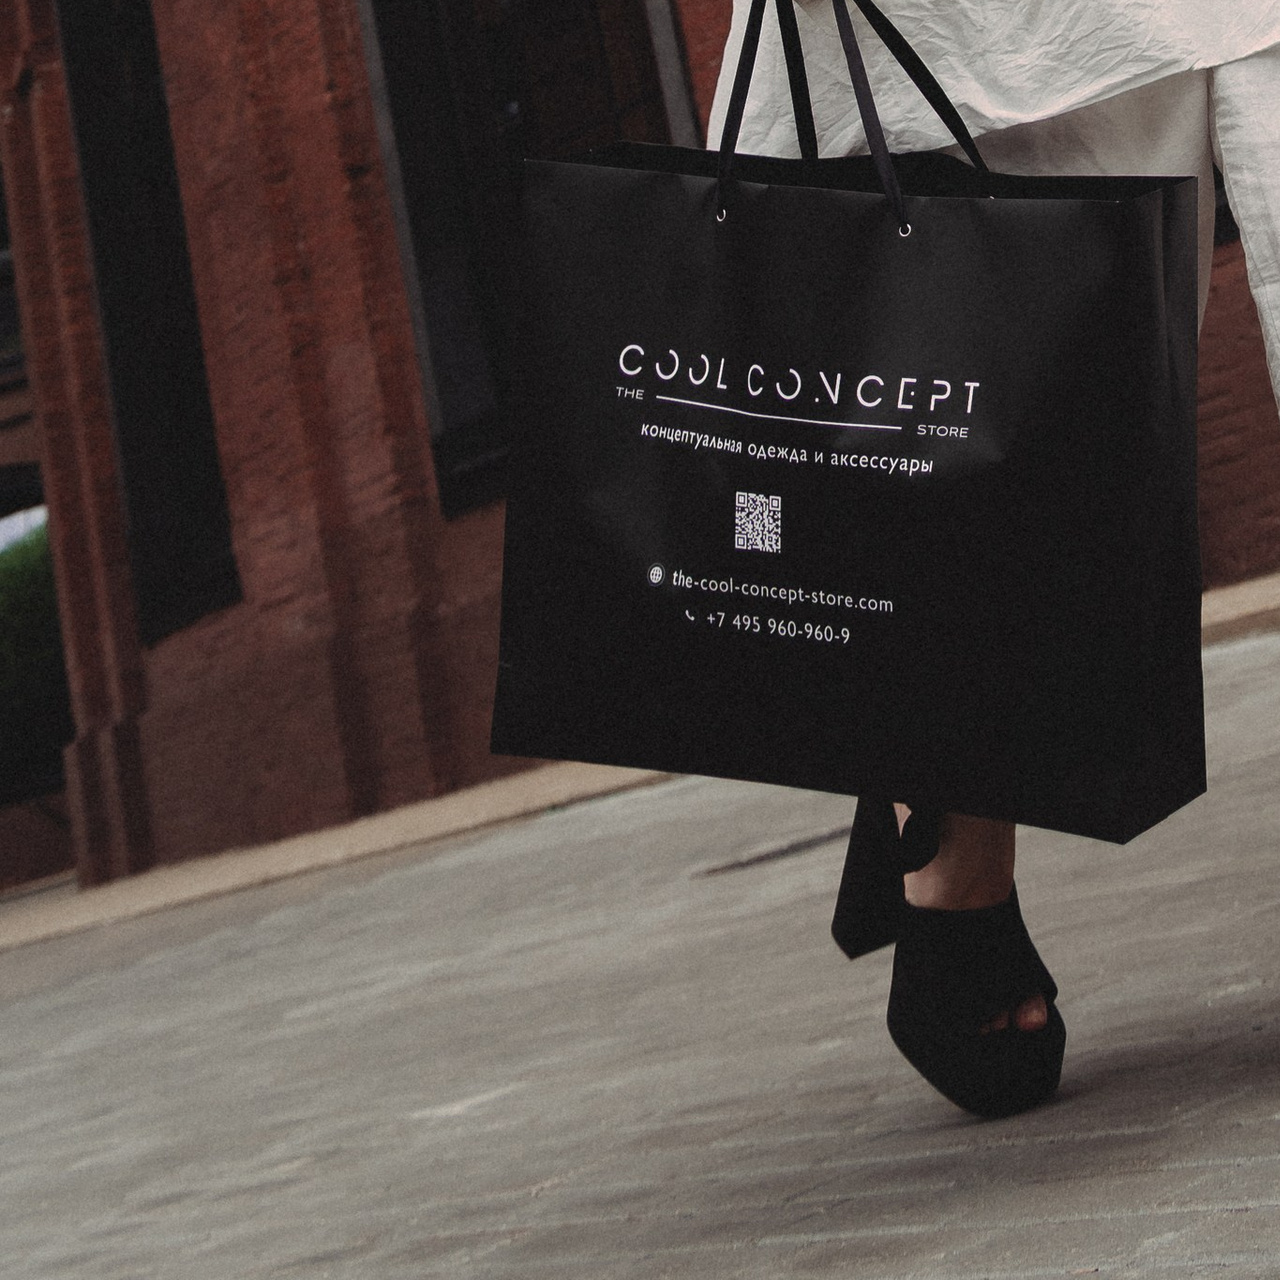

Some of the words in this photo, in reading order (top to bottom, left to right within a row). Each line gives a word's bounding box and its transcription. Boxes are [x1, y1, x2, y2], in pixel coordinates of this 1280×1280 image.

[616, 386, 644, 400] THE
[917, 424, 969, 438] STORE
[641, 423, 742, 453] концептуальная
[748, 443, 807, 463] одежда
[814, 452, 823, 463] и
[830, 452, 933, 475] аксессуары
[672, 569, 894, 613] the-cool-concept-store.com
[707, 612, 725, 627] +7
[732, 614, 761, 633] 495
[767, 618, 850, 644] 960-960-9
